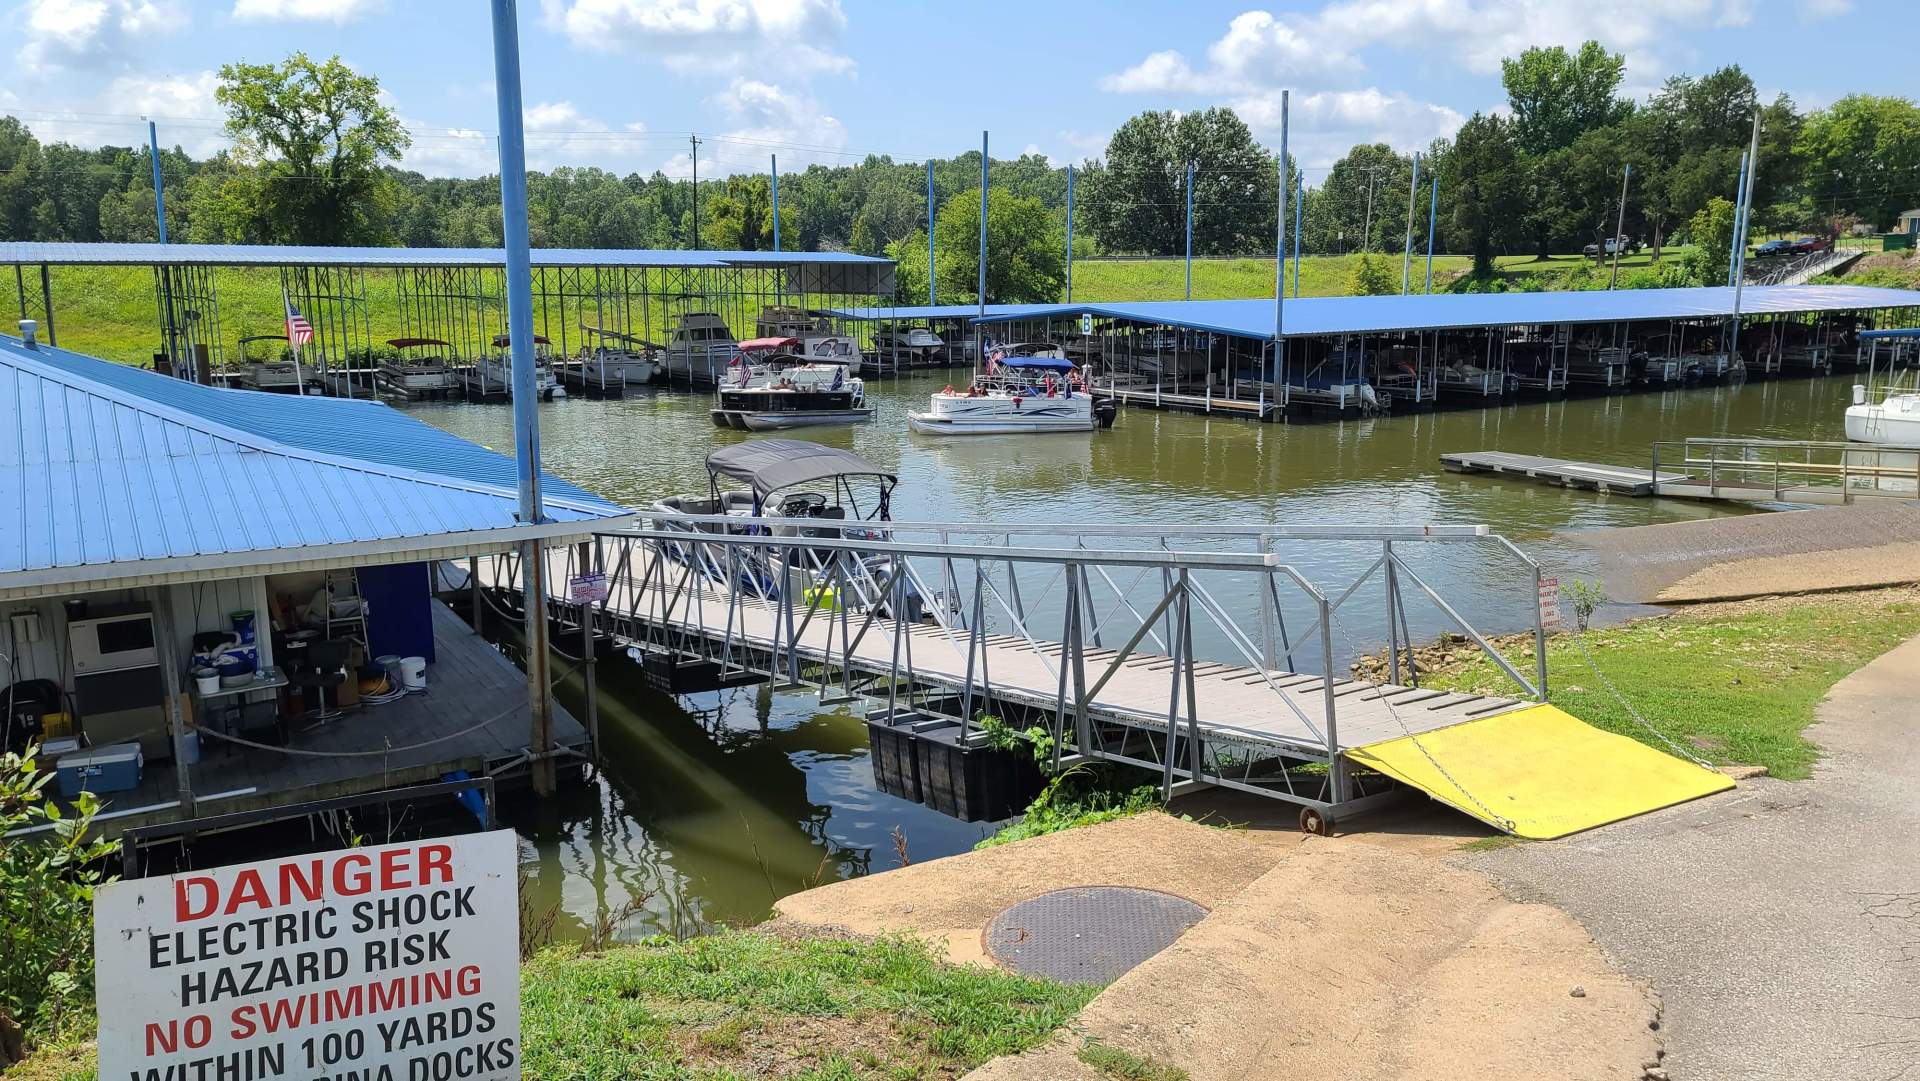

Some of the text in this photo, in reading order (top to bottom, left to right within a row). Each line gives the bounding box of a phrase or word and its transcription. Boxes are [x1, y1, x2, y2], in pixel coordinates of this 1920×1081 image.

[1084, 316, 1090, 332] B
[175, 844, 454, 923] DANGER
[149, 885, 477, 969] ELECTRIC SHOCK
[181, 929, 452, 1007] HAZARD RISK
[145, 965, 481, 1056] NO SWIMMING
[301, 1028, 364, 1069] 100
[376, 1002, 496, 1053] YARDS
[409, 1037, 514, 1081] DOCKS
